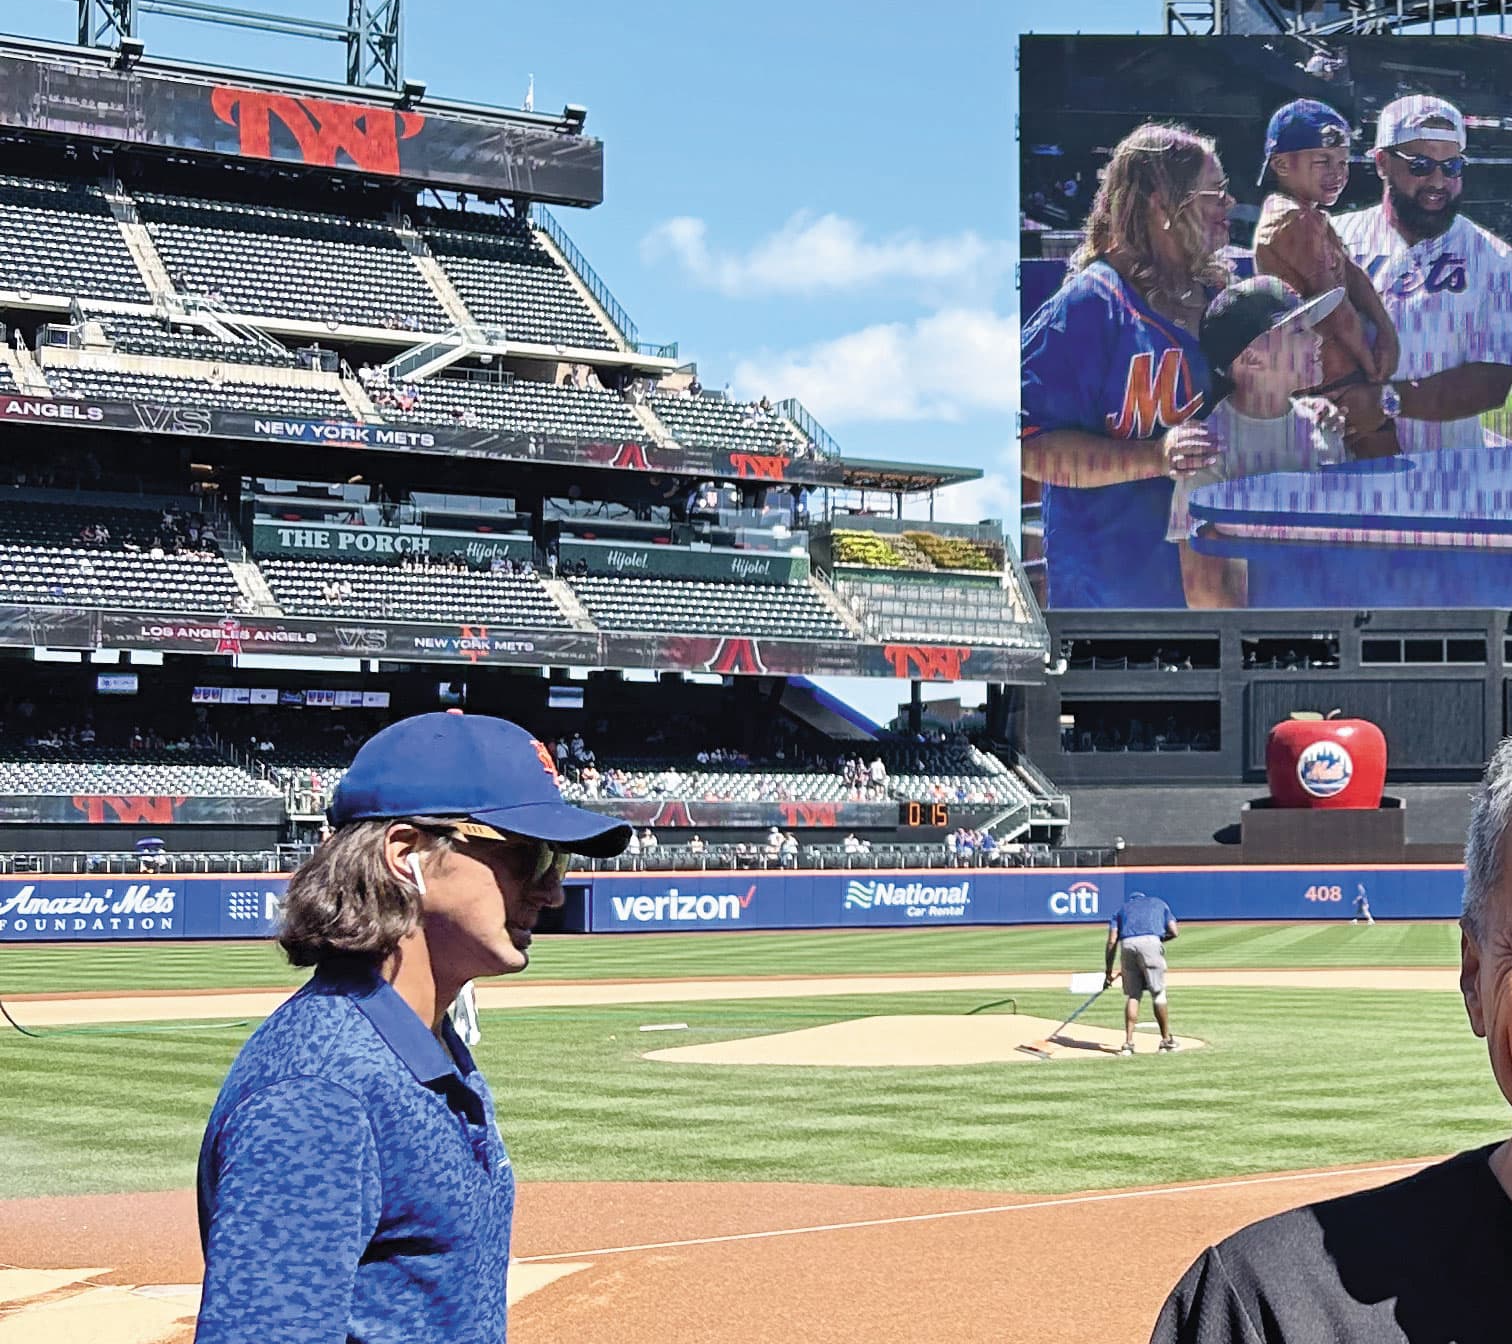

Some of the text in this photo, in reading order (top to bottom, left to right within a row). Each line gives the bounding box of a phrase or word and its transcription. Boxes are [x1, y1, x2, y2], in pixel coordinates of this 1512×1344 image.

[5, 400, 104, 421] ANGELS
[254, 420, 435, 448] NEW YORK METS
[277, 528, 432, 554] THE PORCH
[141, 626, 317, 643] LOS ANGELES ANGELS
[414, 637, 535, 652] NEW YORK METS
[0, 885, 176, 915] Amazin' Mets
[1050, 885, 1099, 915] citi
[1304, 885, 1342, 902] 408
[612, 888, 740, 921] verizon
[907, 905, 964, 916] Car Rental
[0, 918, 173, 932] FOUNDATION
